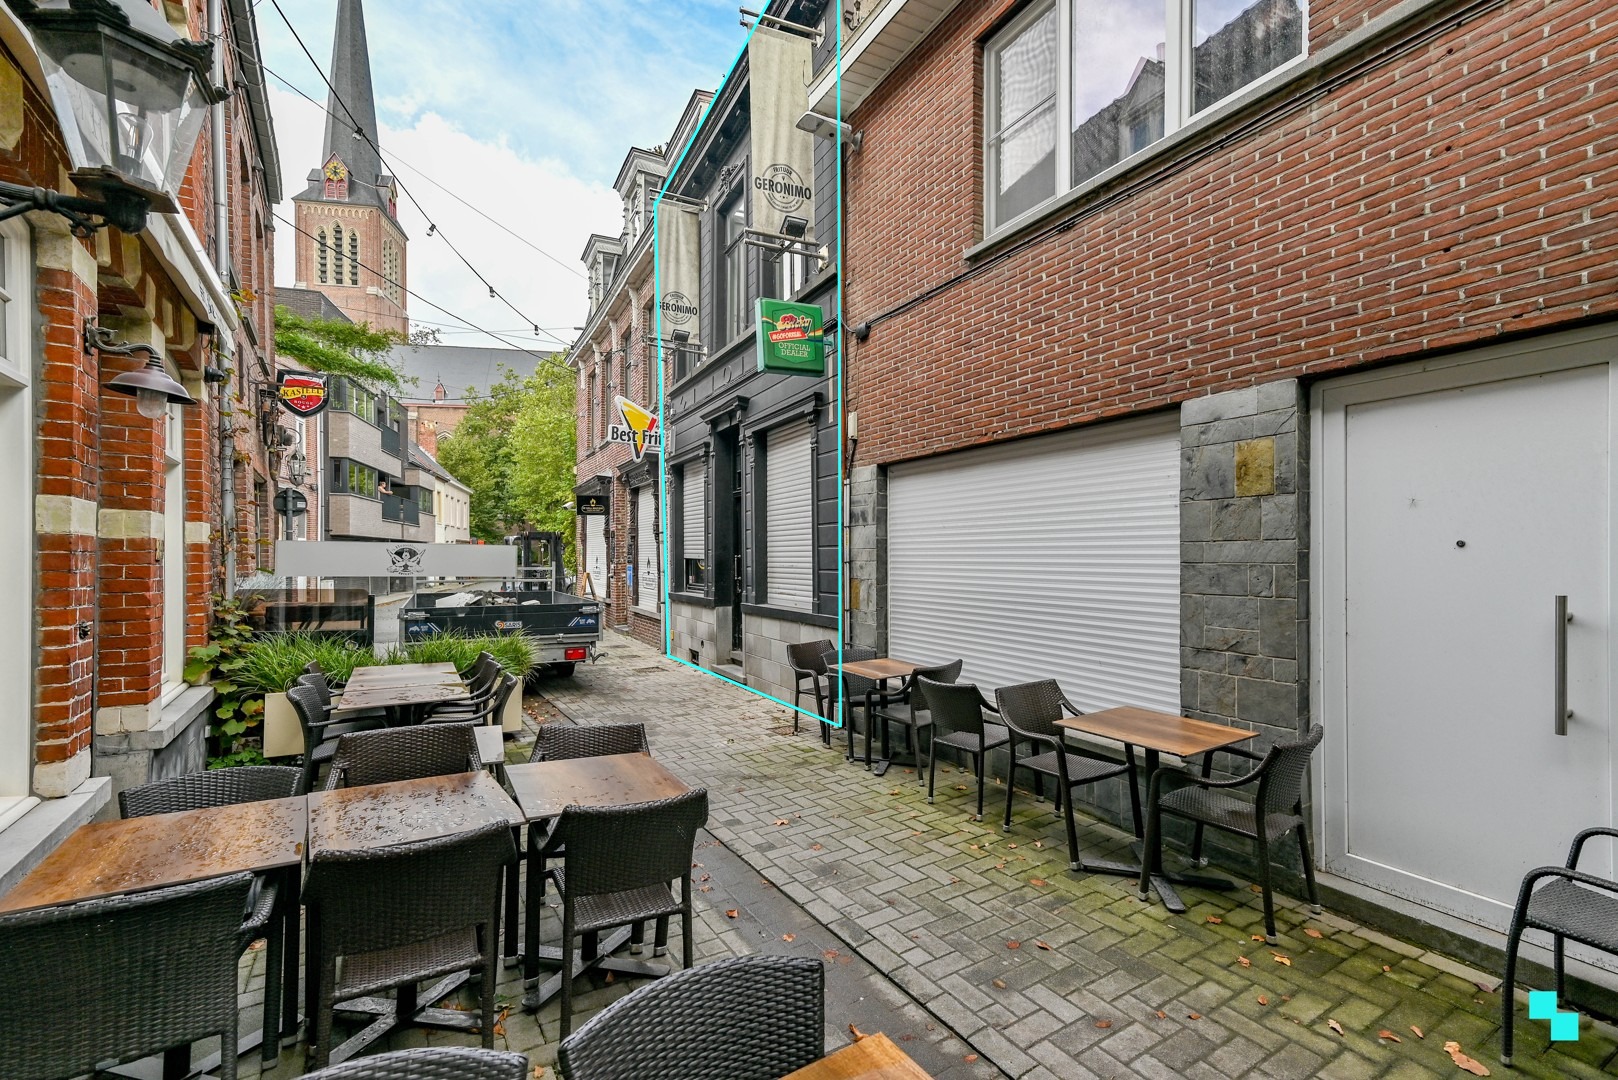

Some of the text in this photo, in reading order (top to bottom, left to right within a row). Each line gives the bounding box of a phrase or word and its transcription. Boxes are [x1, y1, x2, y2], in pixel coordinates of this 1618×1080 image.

[754, 176, 812, 200] GERONIMO
[778, 342, 811, 352] OFFICIAL
[781, 348, 808, 358] DEALER
[610, 425, 639, 443] Best
